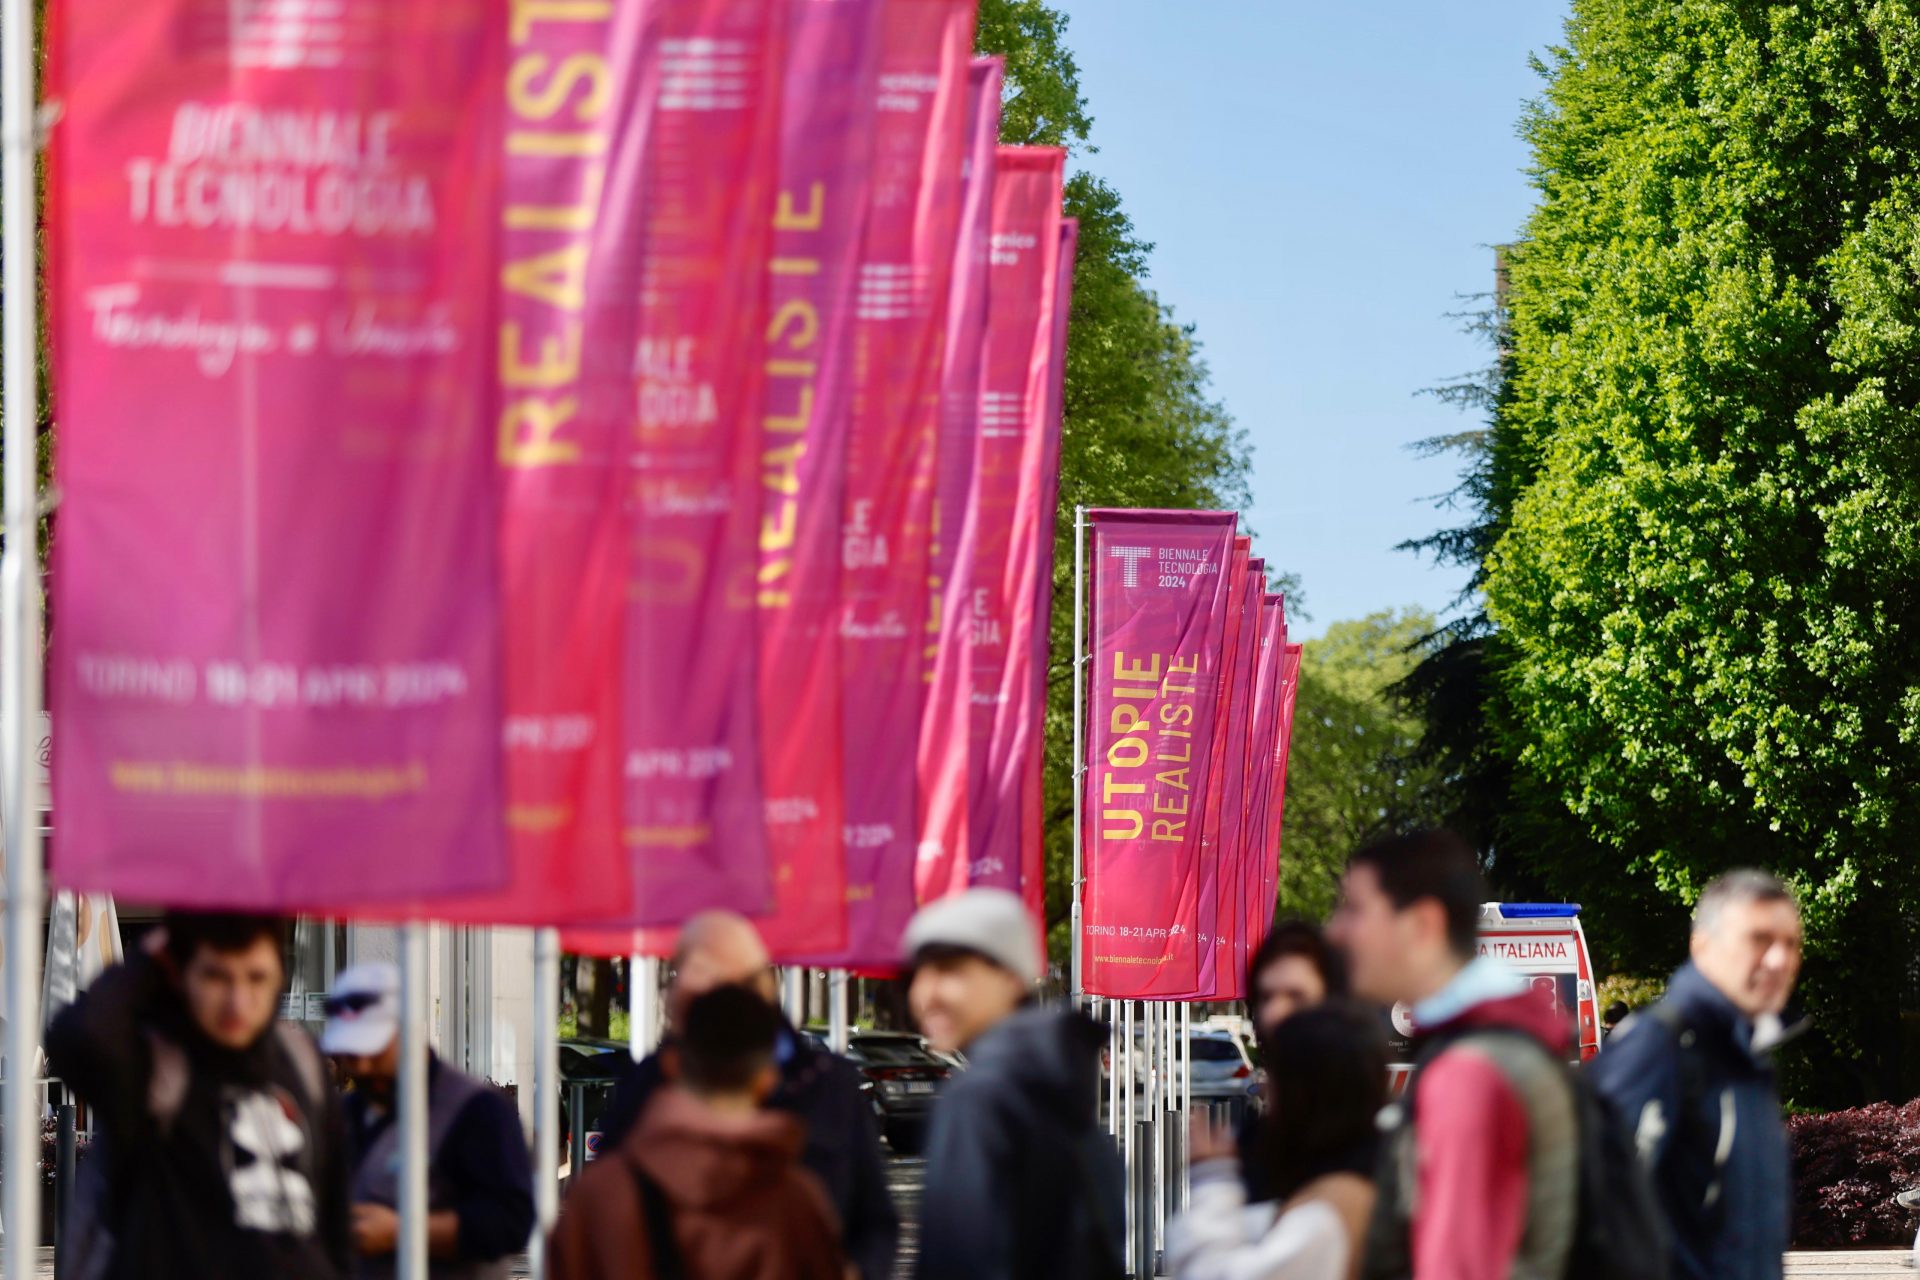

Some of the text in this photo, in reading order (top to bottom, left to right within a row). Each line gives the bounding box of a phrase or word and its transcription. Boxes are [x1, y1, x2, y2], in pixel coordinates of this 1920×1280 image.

[127, 160, 437, 236] TECNOLOGIA
[500, 0, 612, 465] REALIST
[1158, 547, 1209, 561] BIENNALE
[1158, 561, 1218, 575] TECNOLOGIA
[1158, 575, 1186, 588] 2024
[1103, 652, 1161, 839] UTOPIE
[1151, 653, 1199, 842] REALISTE
[1086, 925, 1116, 936] TORINO
[1120, 926, 1143, 937] 18-21
[1145, 928, 1167, 938] APR
[1493, 942, 1567, 958] ITALIANA
